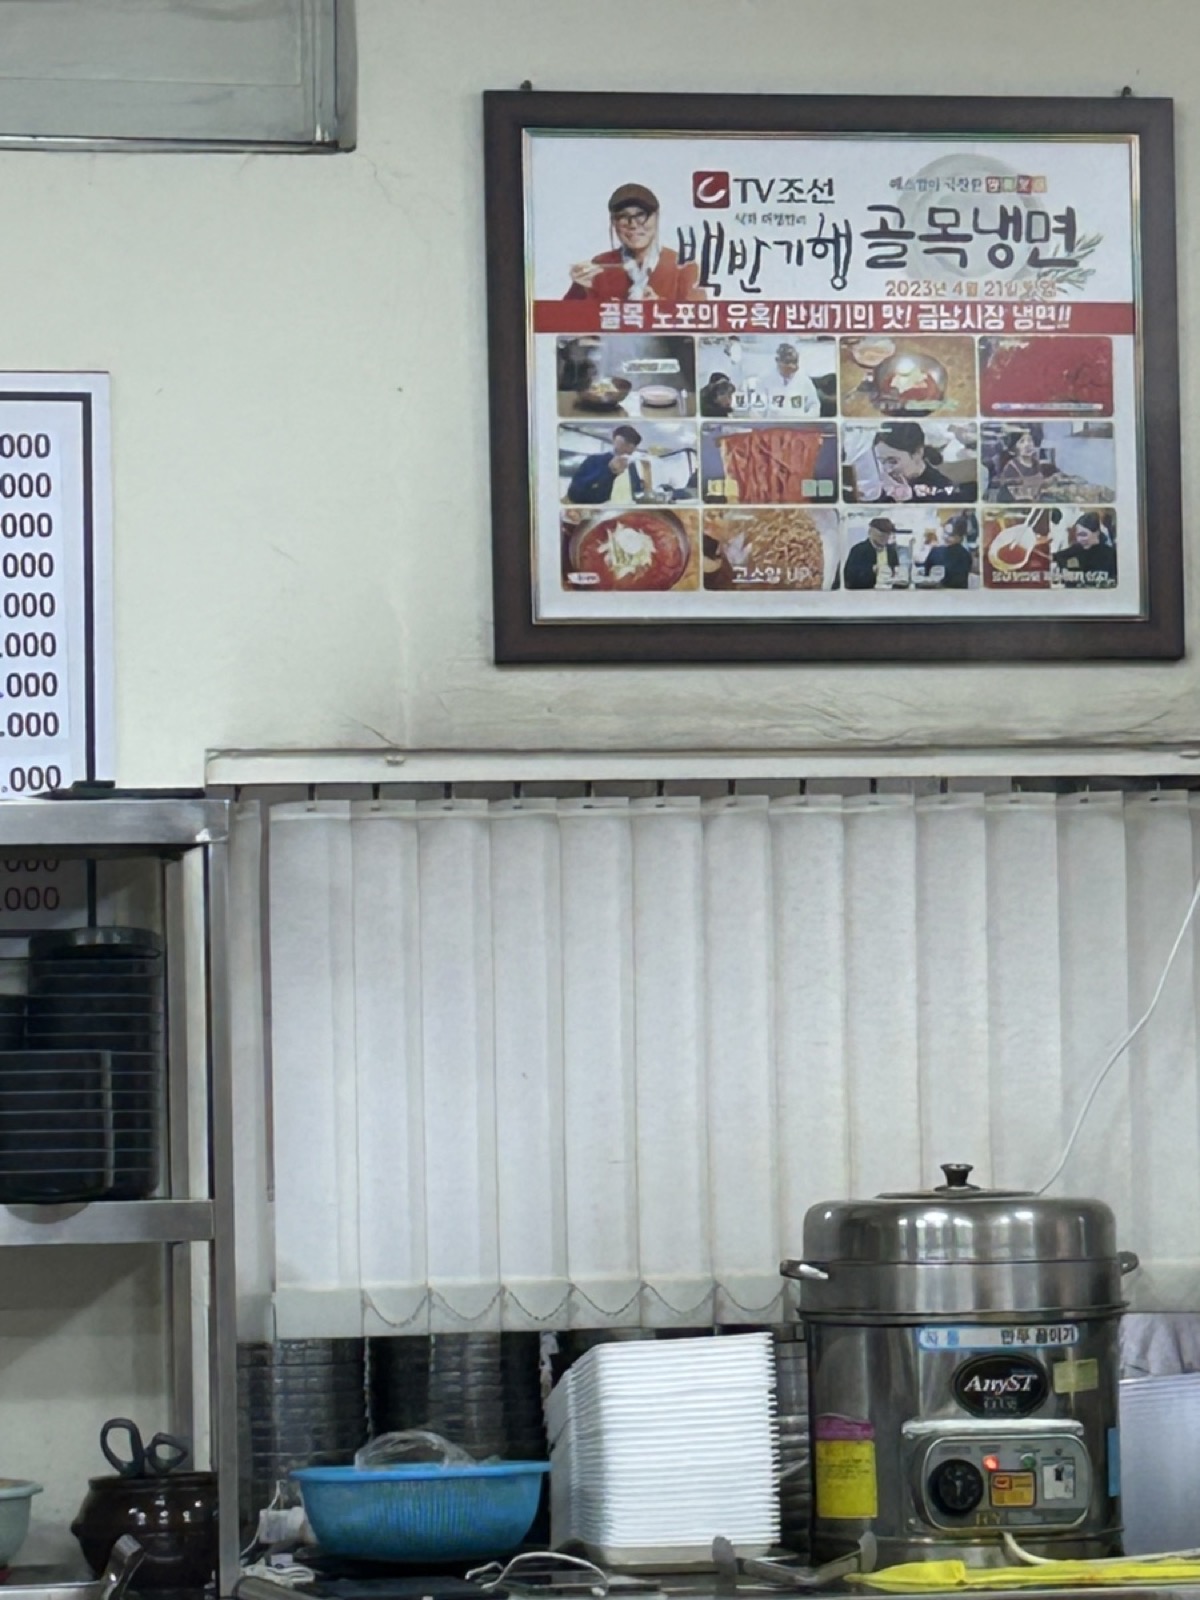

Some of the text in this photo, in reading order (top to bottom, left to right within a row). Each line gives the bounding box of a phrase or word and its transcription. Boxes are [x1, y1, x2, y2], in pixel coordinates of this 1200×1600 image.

[733, 178, 835, 204] TV조선
[860, 204, 1079, 269] 골목냉면
[677, 212, 853, 297] 백반기행
[600, 303, 644, 330] 골목
[652, 303, 719, 330] 노포의
[727, 303, 780, 330] 유혹!
[786, 303, 874, 330] 반세기의
[882, 303, 912, 330] 맛!
[917, 304, 1005, 330] 금남시장
[0, 512, 53, 538] 000
[3, 552, 54, 578] 000
